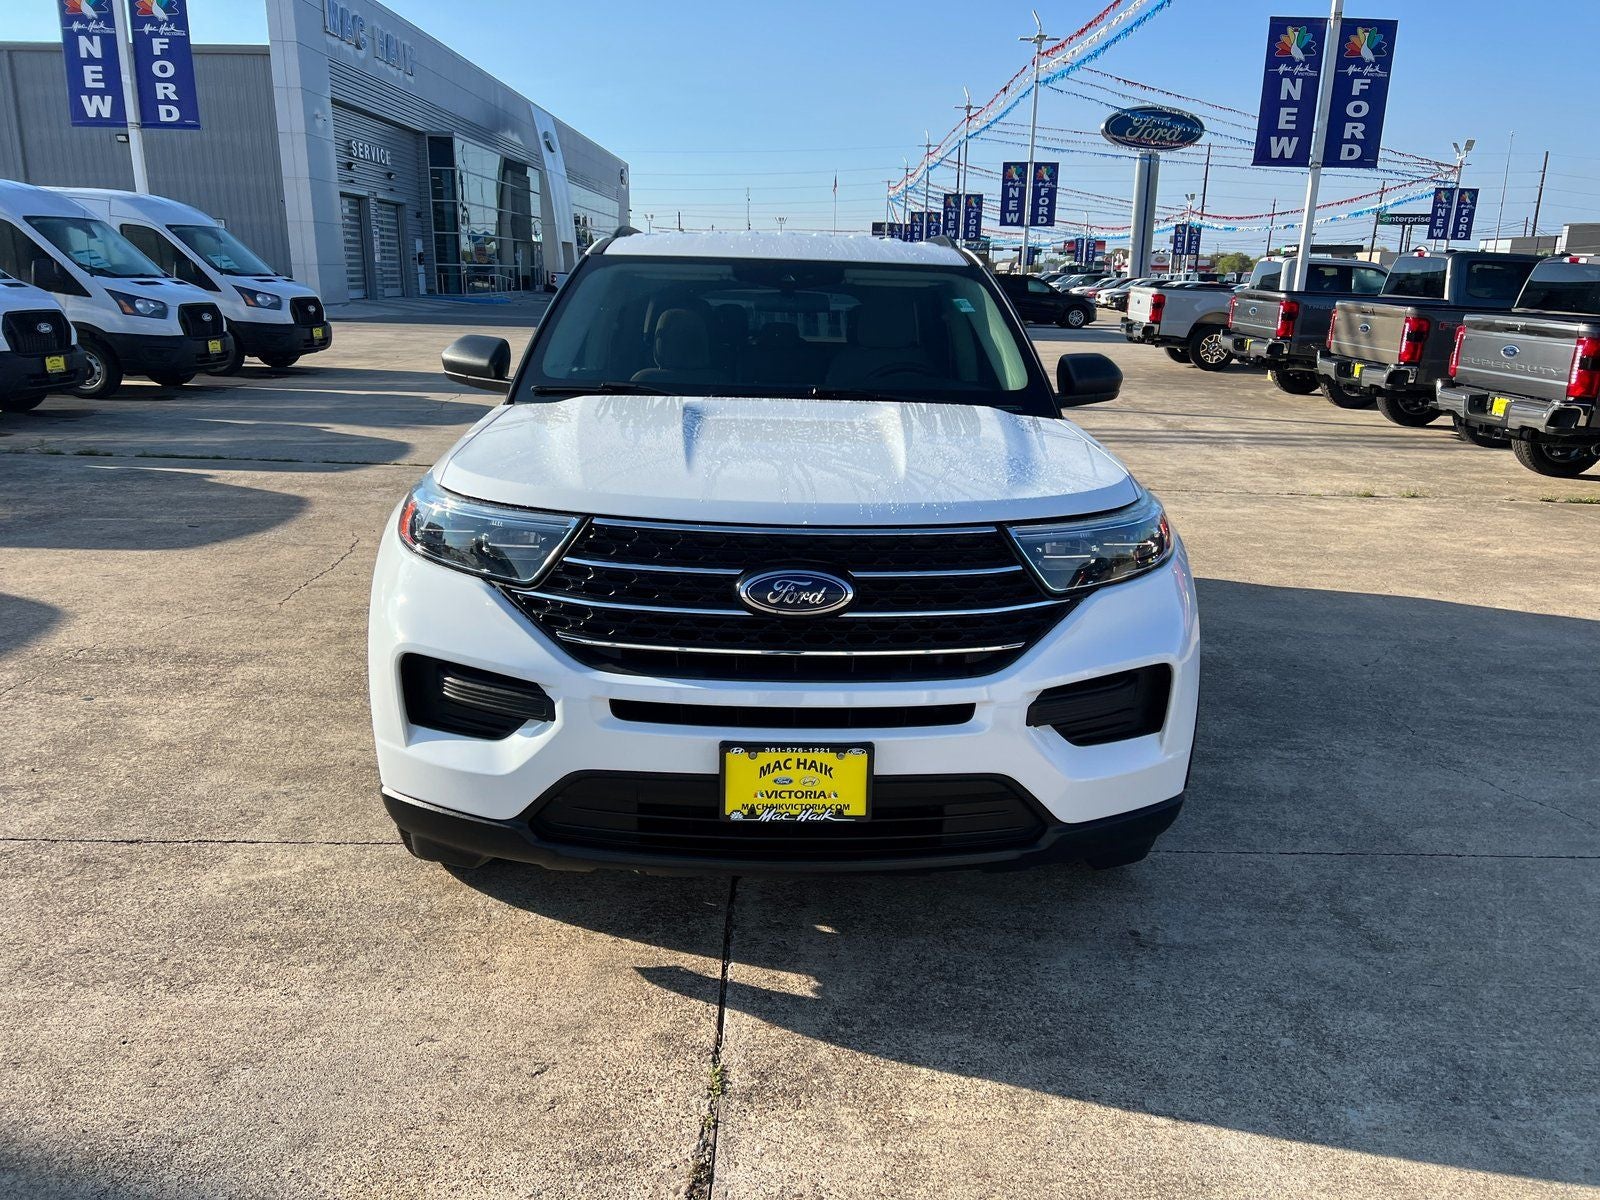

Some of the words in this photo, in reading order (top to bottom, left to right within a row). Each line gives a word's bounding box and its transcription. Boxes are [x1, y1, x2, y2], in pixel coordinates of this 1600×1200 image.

[78, 35, 112, 118] NEW
[151, 38, 180, 122] FORD
[1270, 77, 1303, 159] NEW
[1339, 78, 1371, 161] FORD
[351, 140, 391, 165] SERVICE
[1005, 187, 1020, 223] NEW
[1037, 187, 1050, 224] FORD
[946, 211, 957, 238] NEW
[968, 211, 977, 239] FORD
[1382, 215, 1431, 224] enterprise
[1433, 208, 1446, 238] NEW
[1457, 208, 1469, 238] FORD
[1462, 356, 1512, 370] SUPER
[1515, 363, 1566, 377] DUTY
[767, 579, 827, 604] Ford
[759, 758, 793, 778] MAC
[796, 757, 834, 779] HAIK
[765, 790, 828, 799] VICTORIA
[759, 807, 790, 822] Mac
[796, 807, 834, 822] Haik
